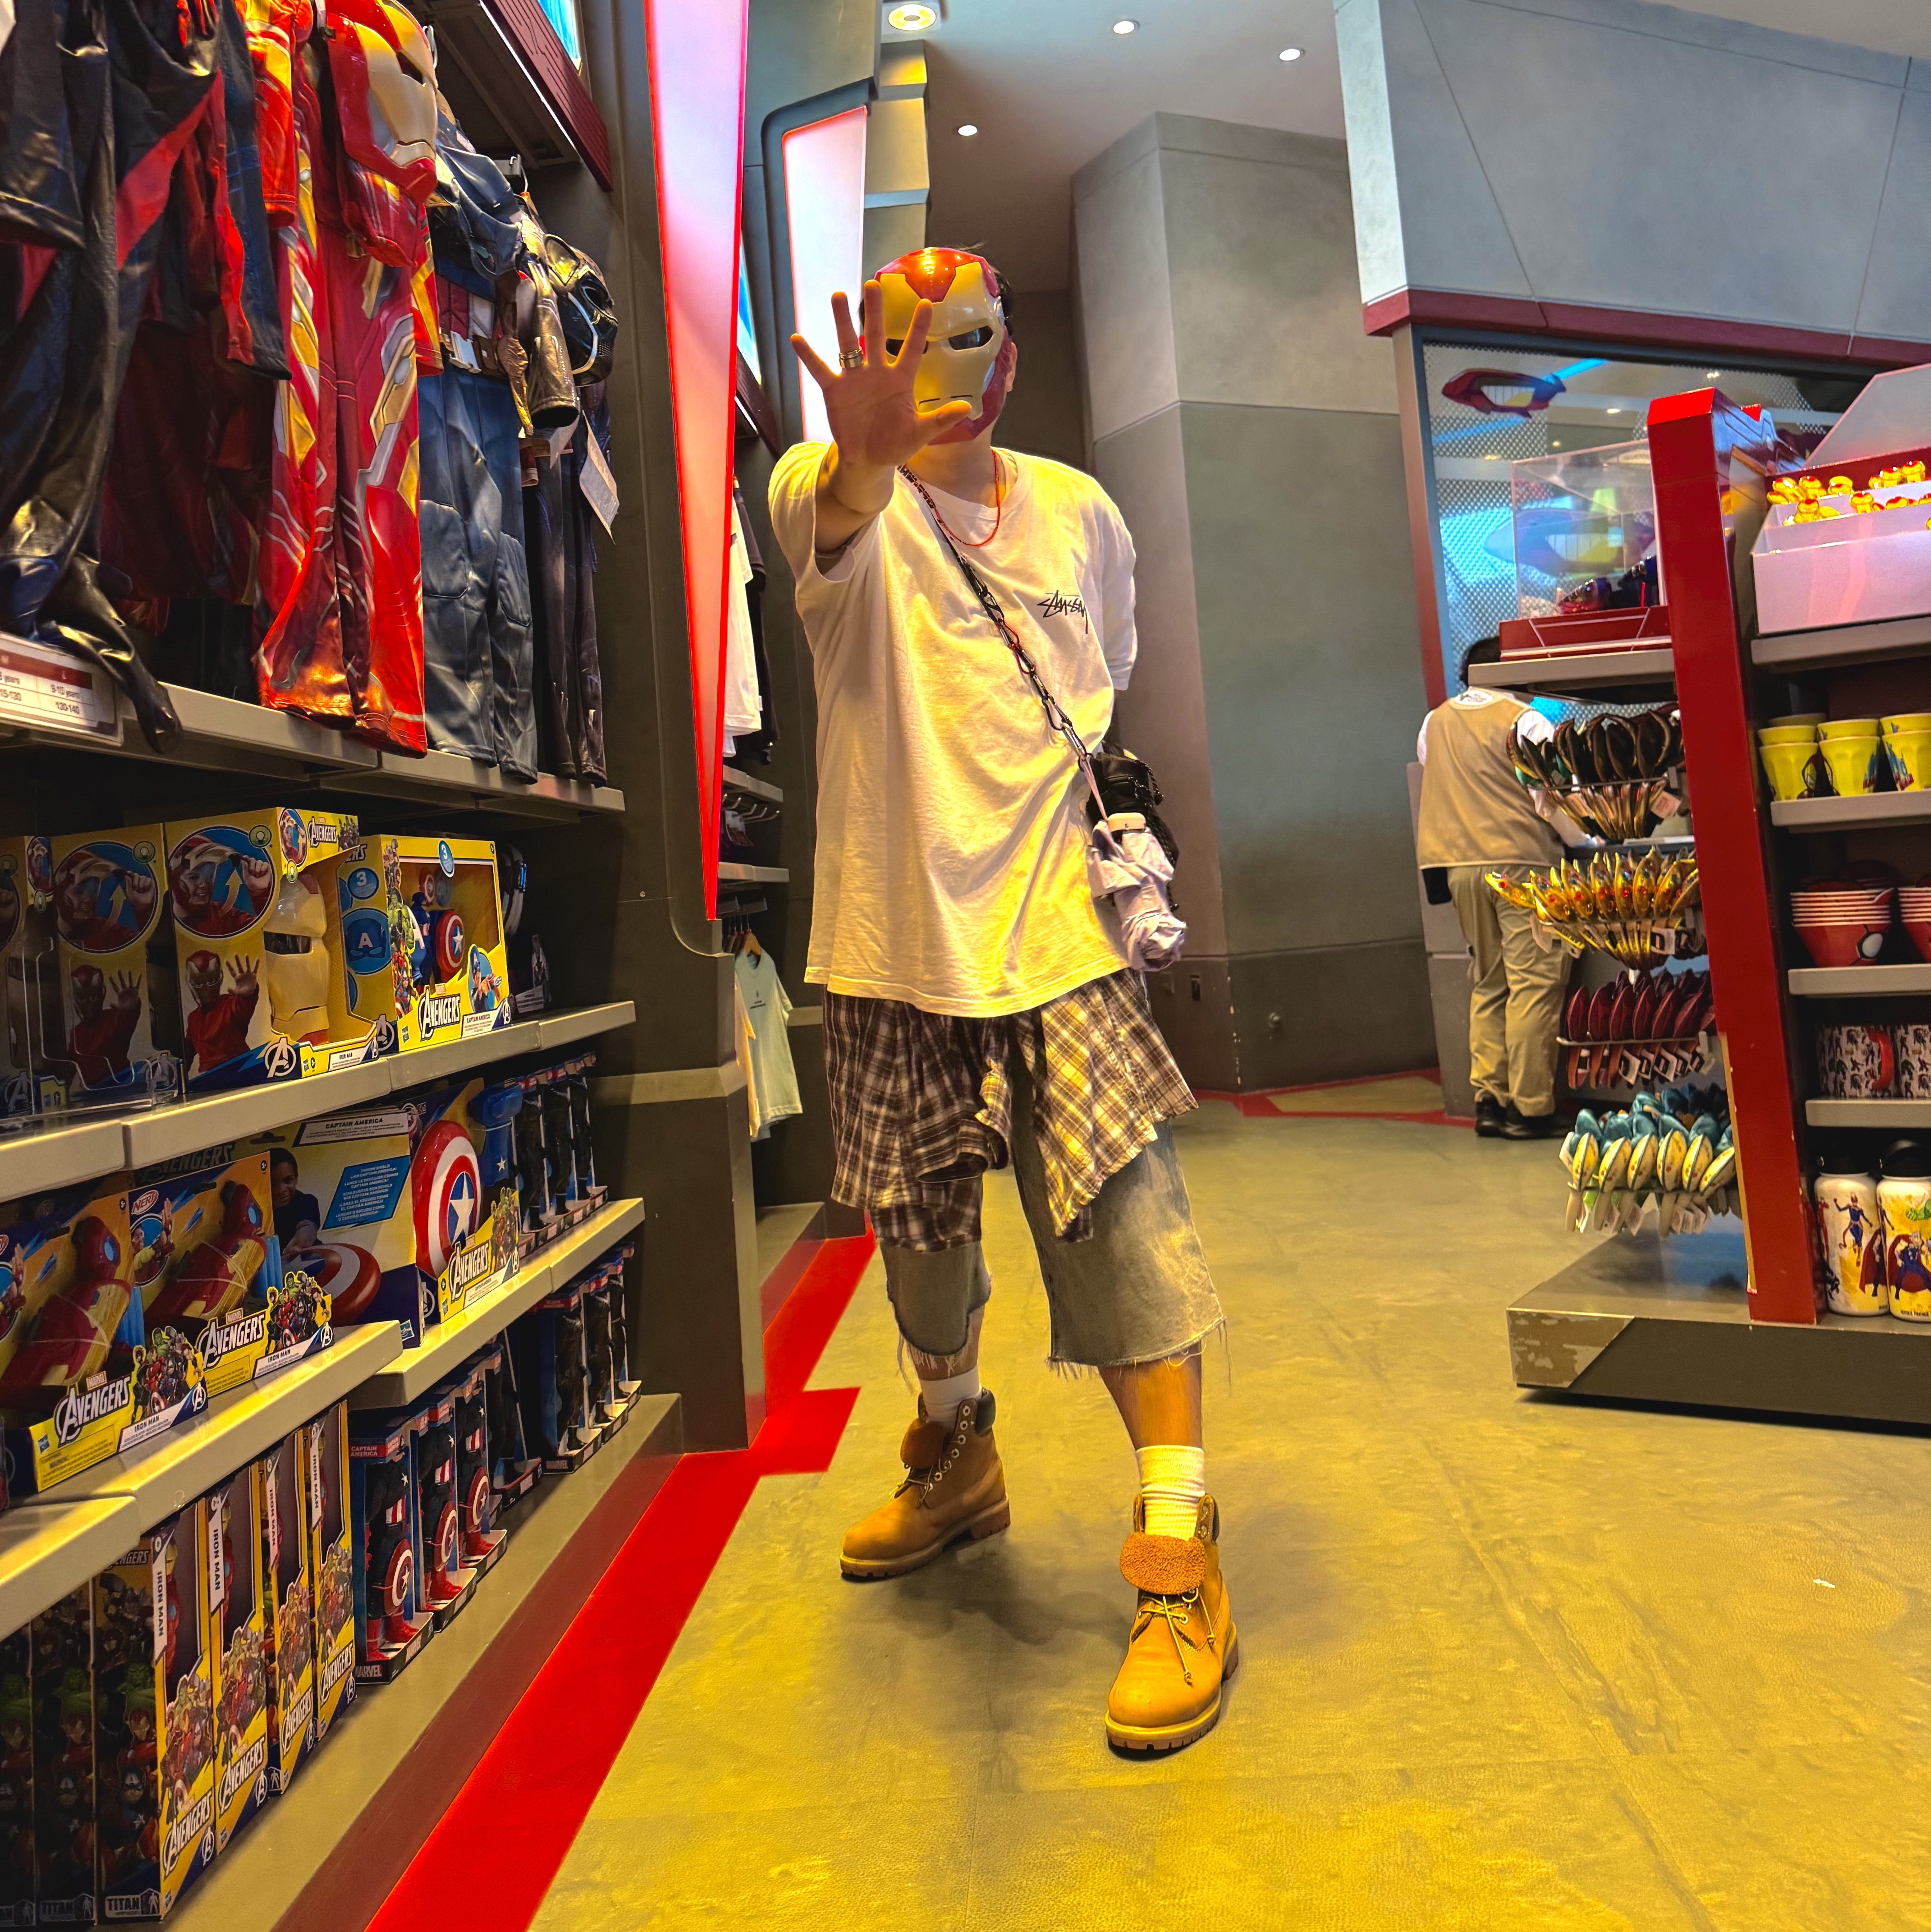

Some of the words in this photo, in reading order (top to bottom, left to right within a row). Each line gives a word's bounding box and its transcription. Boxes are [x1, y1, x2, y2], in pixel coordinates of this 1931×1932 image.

[61, 670, 67, 679] L
[308, 816, 337, 846] AVENGERS
[441, 844, 448, 860] 3
[356, 871, 367, 887] 3
[358, 932, 373, 949] A
[418, 988, 461, 1040] AVENGERS
[354, 1118, 383, 1126] AMERICA
[134, 1192, 156, 1211] NERF
[449, 1243, 489, 1301] AVENGERS
[227, 1311, 242, 1323] MARVEL
[198, 1314, 265, 1370] AVENGERS
[268, 1354, 279, 1363] IRON
[280, 1349, 291, 1358] MAN
[55, 1377, 131, 1444] AVENGERS
[135, 1420, 147, 1432] IRON
[148, 1415, 160, 1427] MAN
[320, 1643, 353, 1706] AVENGERS
[282, 1688, 312, 1757] AVENGERS
[219, 1736, 265, 1816] AVENGERS
[164, 1790, 212, 1877] AVENGERS
[107, 1897, 140, 1912] TITAN
